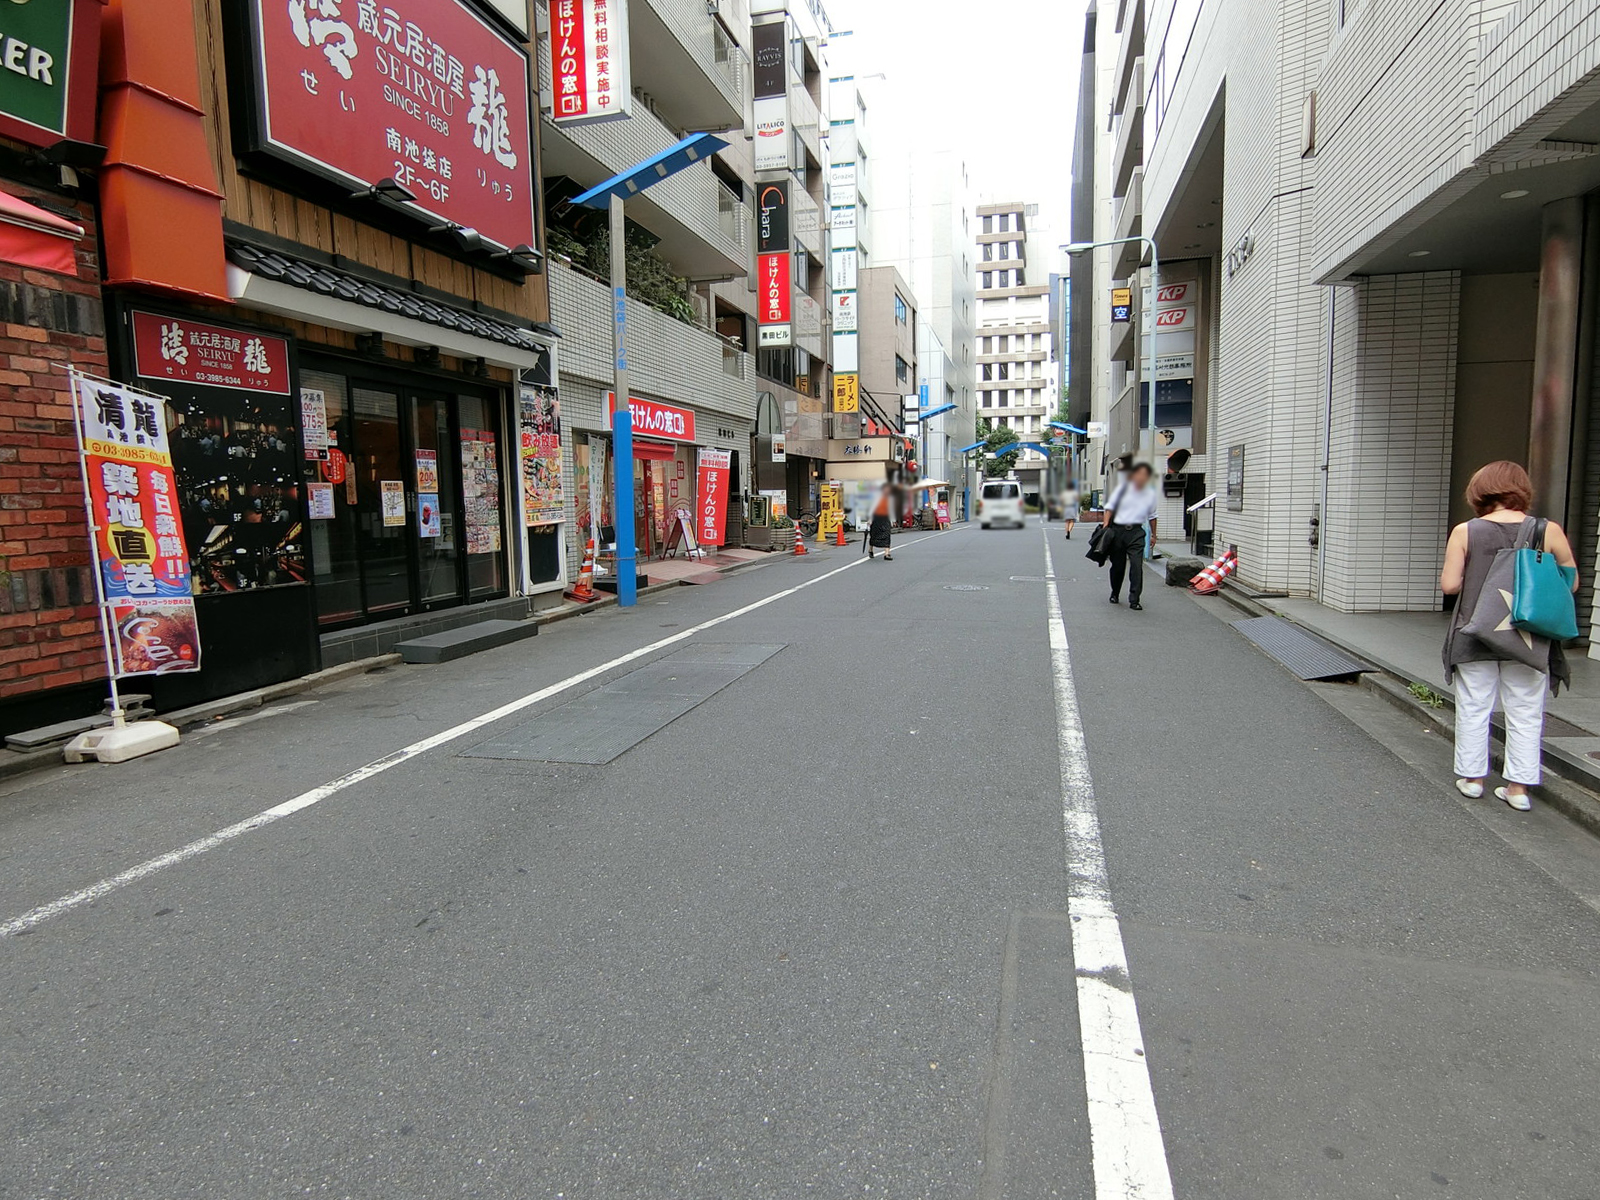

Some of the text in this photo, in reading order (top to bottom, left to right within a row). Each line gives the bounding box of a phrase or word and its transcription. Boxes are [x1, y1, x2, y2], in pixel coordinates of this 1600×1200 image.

[0, 32, 53, 86] ER
[375, 45, 455, 117] SEIRYU
[383, 84, 450, 137] SINCE 1858
[467, 64, 518, 169] 龍
[757, 121, 785, 130] LITALICO
[386, 127, 452, 180] 南池袋店
[769, 257, 782, 320] ほけんの窓口
[1114, 306, 1128, 320] 空
[1157, 286, 1185, 300] TKP
[615, 287, 628, 371] 南池袋パーク街
[1156, 311, 1184, 324] TKP
[198, 347, 235, 363] SEIRYU
[847, 376, 855, 411] ラーメン
[101, 462, 157, 595] 築地直送
[703, 471, 718, 540] ほけんの窓口
